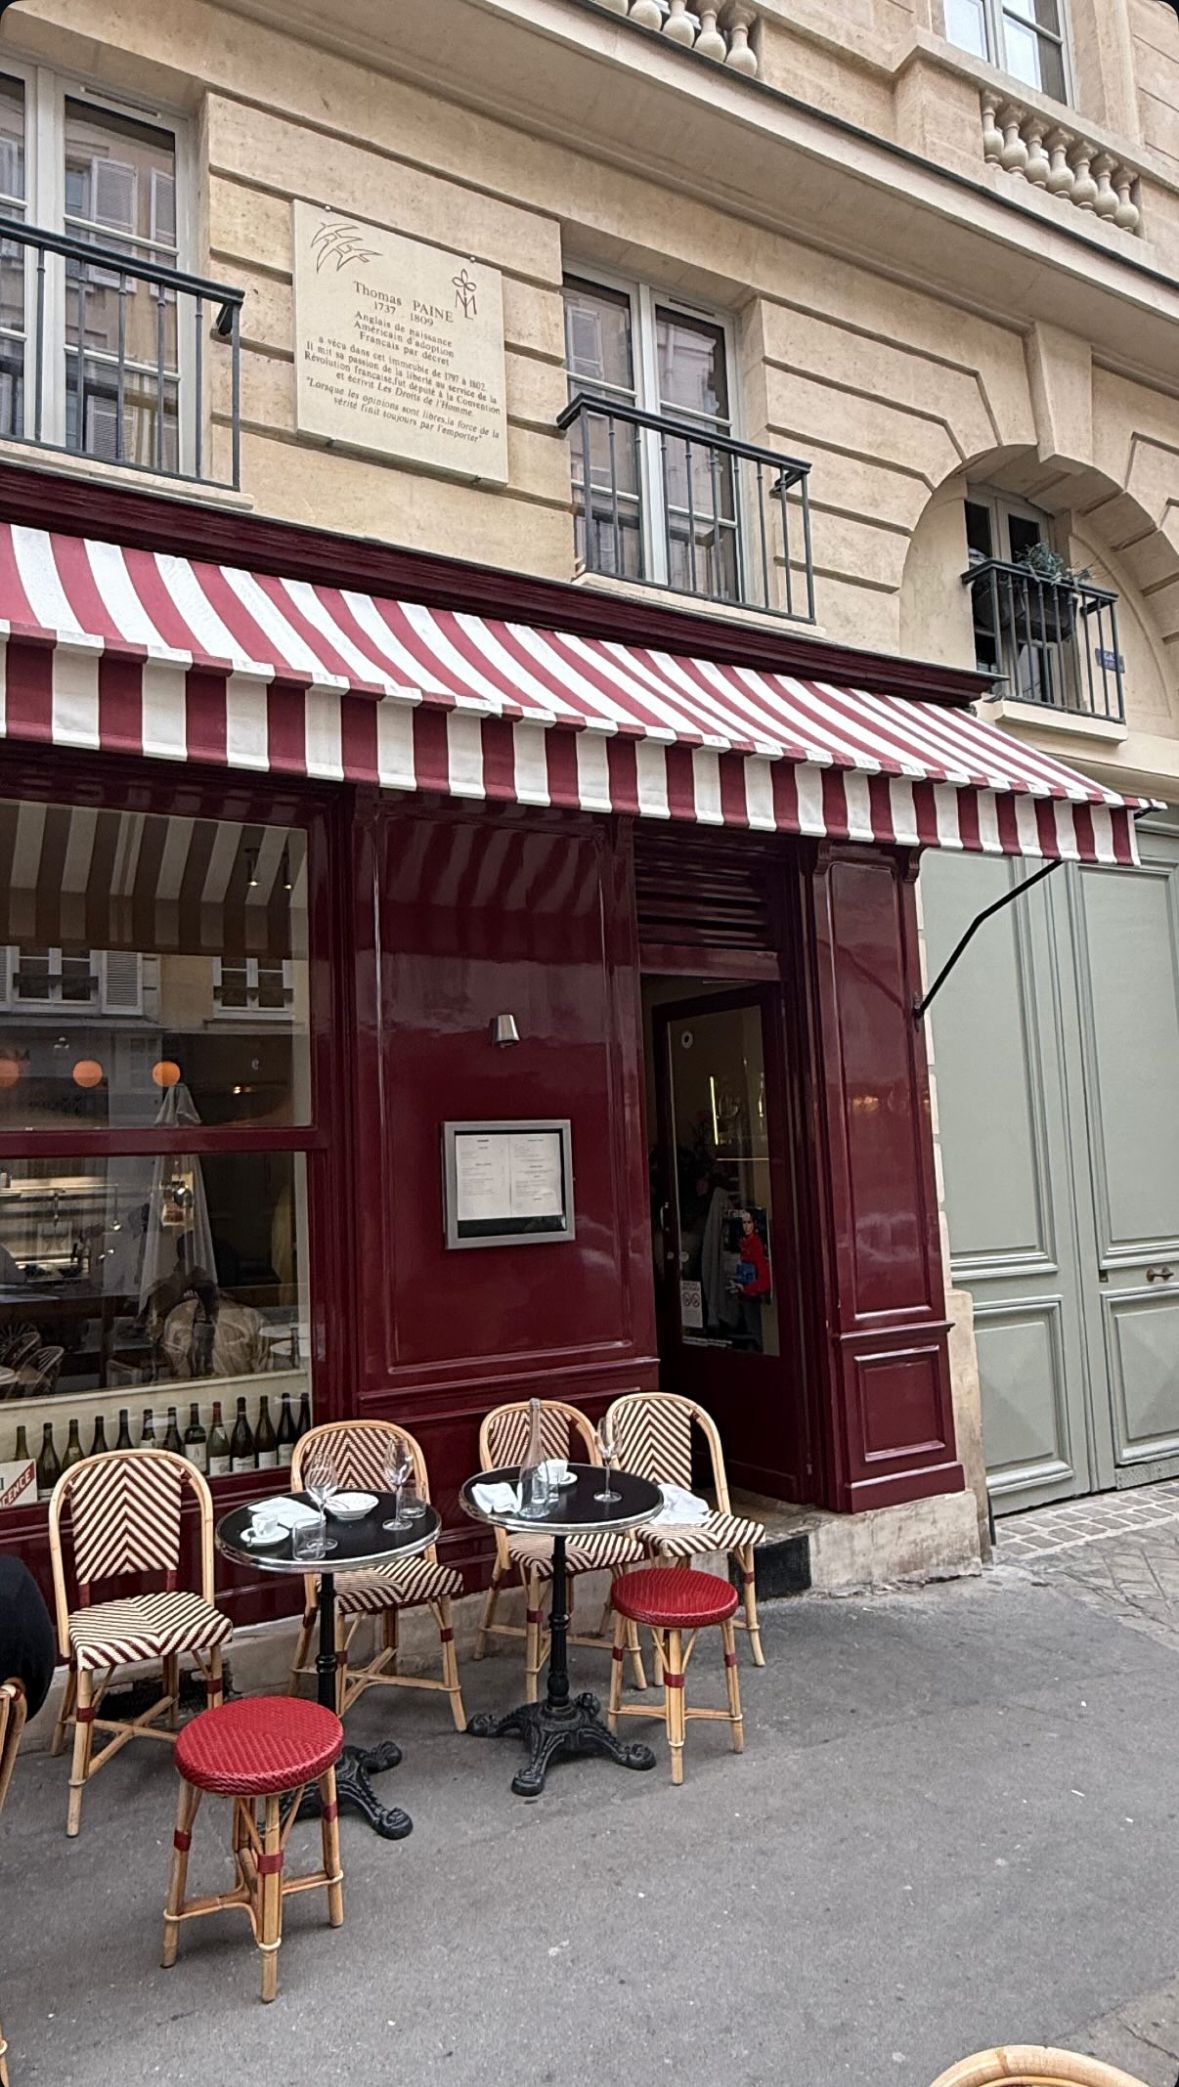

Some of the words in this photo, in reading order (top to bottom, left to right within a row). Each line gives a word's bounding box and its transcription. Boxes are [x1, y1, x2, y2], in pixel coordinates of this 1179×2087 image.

[353, 280, 402, 306] Thomas
[413, 299, 454, 323] PAINE
[374, 301, 396, 315] 1737
[410, 312, 433, 326] 1809
[354, 320, 403, 343] Américain
[407, 335, 454, 358] d'adoption
[355, 310, 391, 329] Anglais
[395, 323, 405, 333] de
[409, 328, 452, 347] naissance
[306, 340, 313, 351] Il
[317, 346, 332, 356] mit
[335, 351, 344, 360] sa
[348, 355, 380, 370] passion
[382, 364, 392, 374] de
[395, 367, 403, 377] la
[435, 381, 445, 390] au
[448, 384, 475, 398] service
[477, 392, 487, 402] de
[490, 395, 497, 405] la
[328, 338, 346, 350] vécu
[350, 344, 370, 357] dans
[372, 352, 385, 362] cet
[389, 355, 429, 375] immeuble
[432, 368, 441, 378] de
[403, 346, 418, 356] par
[422, 350, 449, 366] décret
[304, 350, 351, 373] Révolution
[446, 392, 454, 402] la
[456, 395, 501, 415] Convention
[336, 372, 345, 381] et
[377, 382, 392, 394] Les
[395, 386, 420, 402] Droits
[423, 396, 434, 406] de
[347, 389, 359, 400] les
[362, 394, 399, 411] opinions
[402, 406, 420, 417] sont
[457, 420, 477, 433] force
[479, 427, 489, 436] de
[492, 429, 500, 439] la
[361, 402, 381, 416] finit
[383, 410, 417, 426] toujours
[420, 420, 434, 431] par
